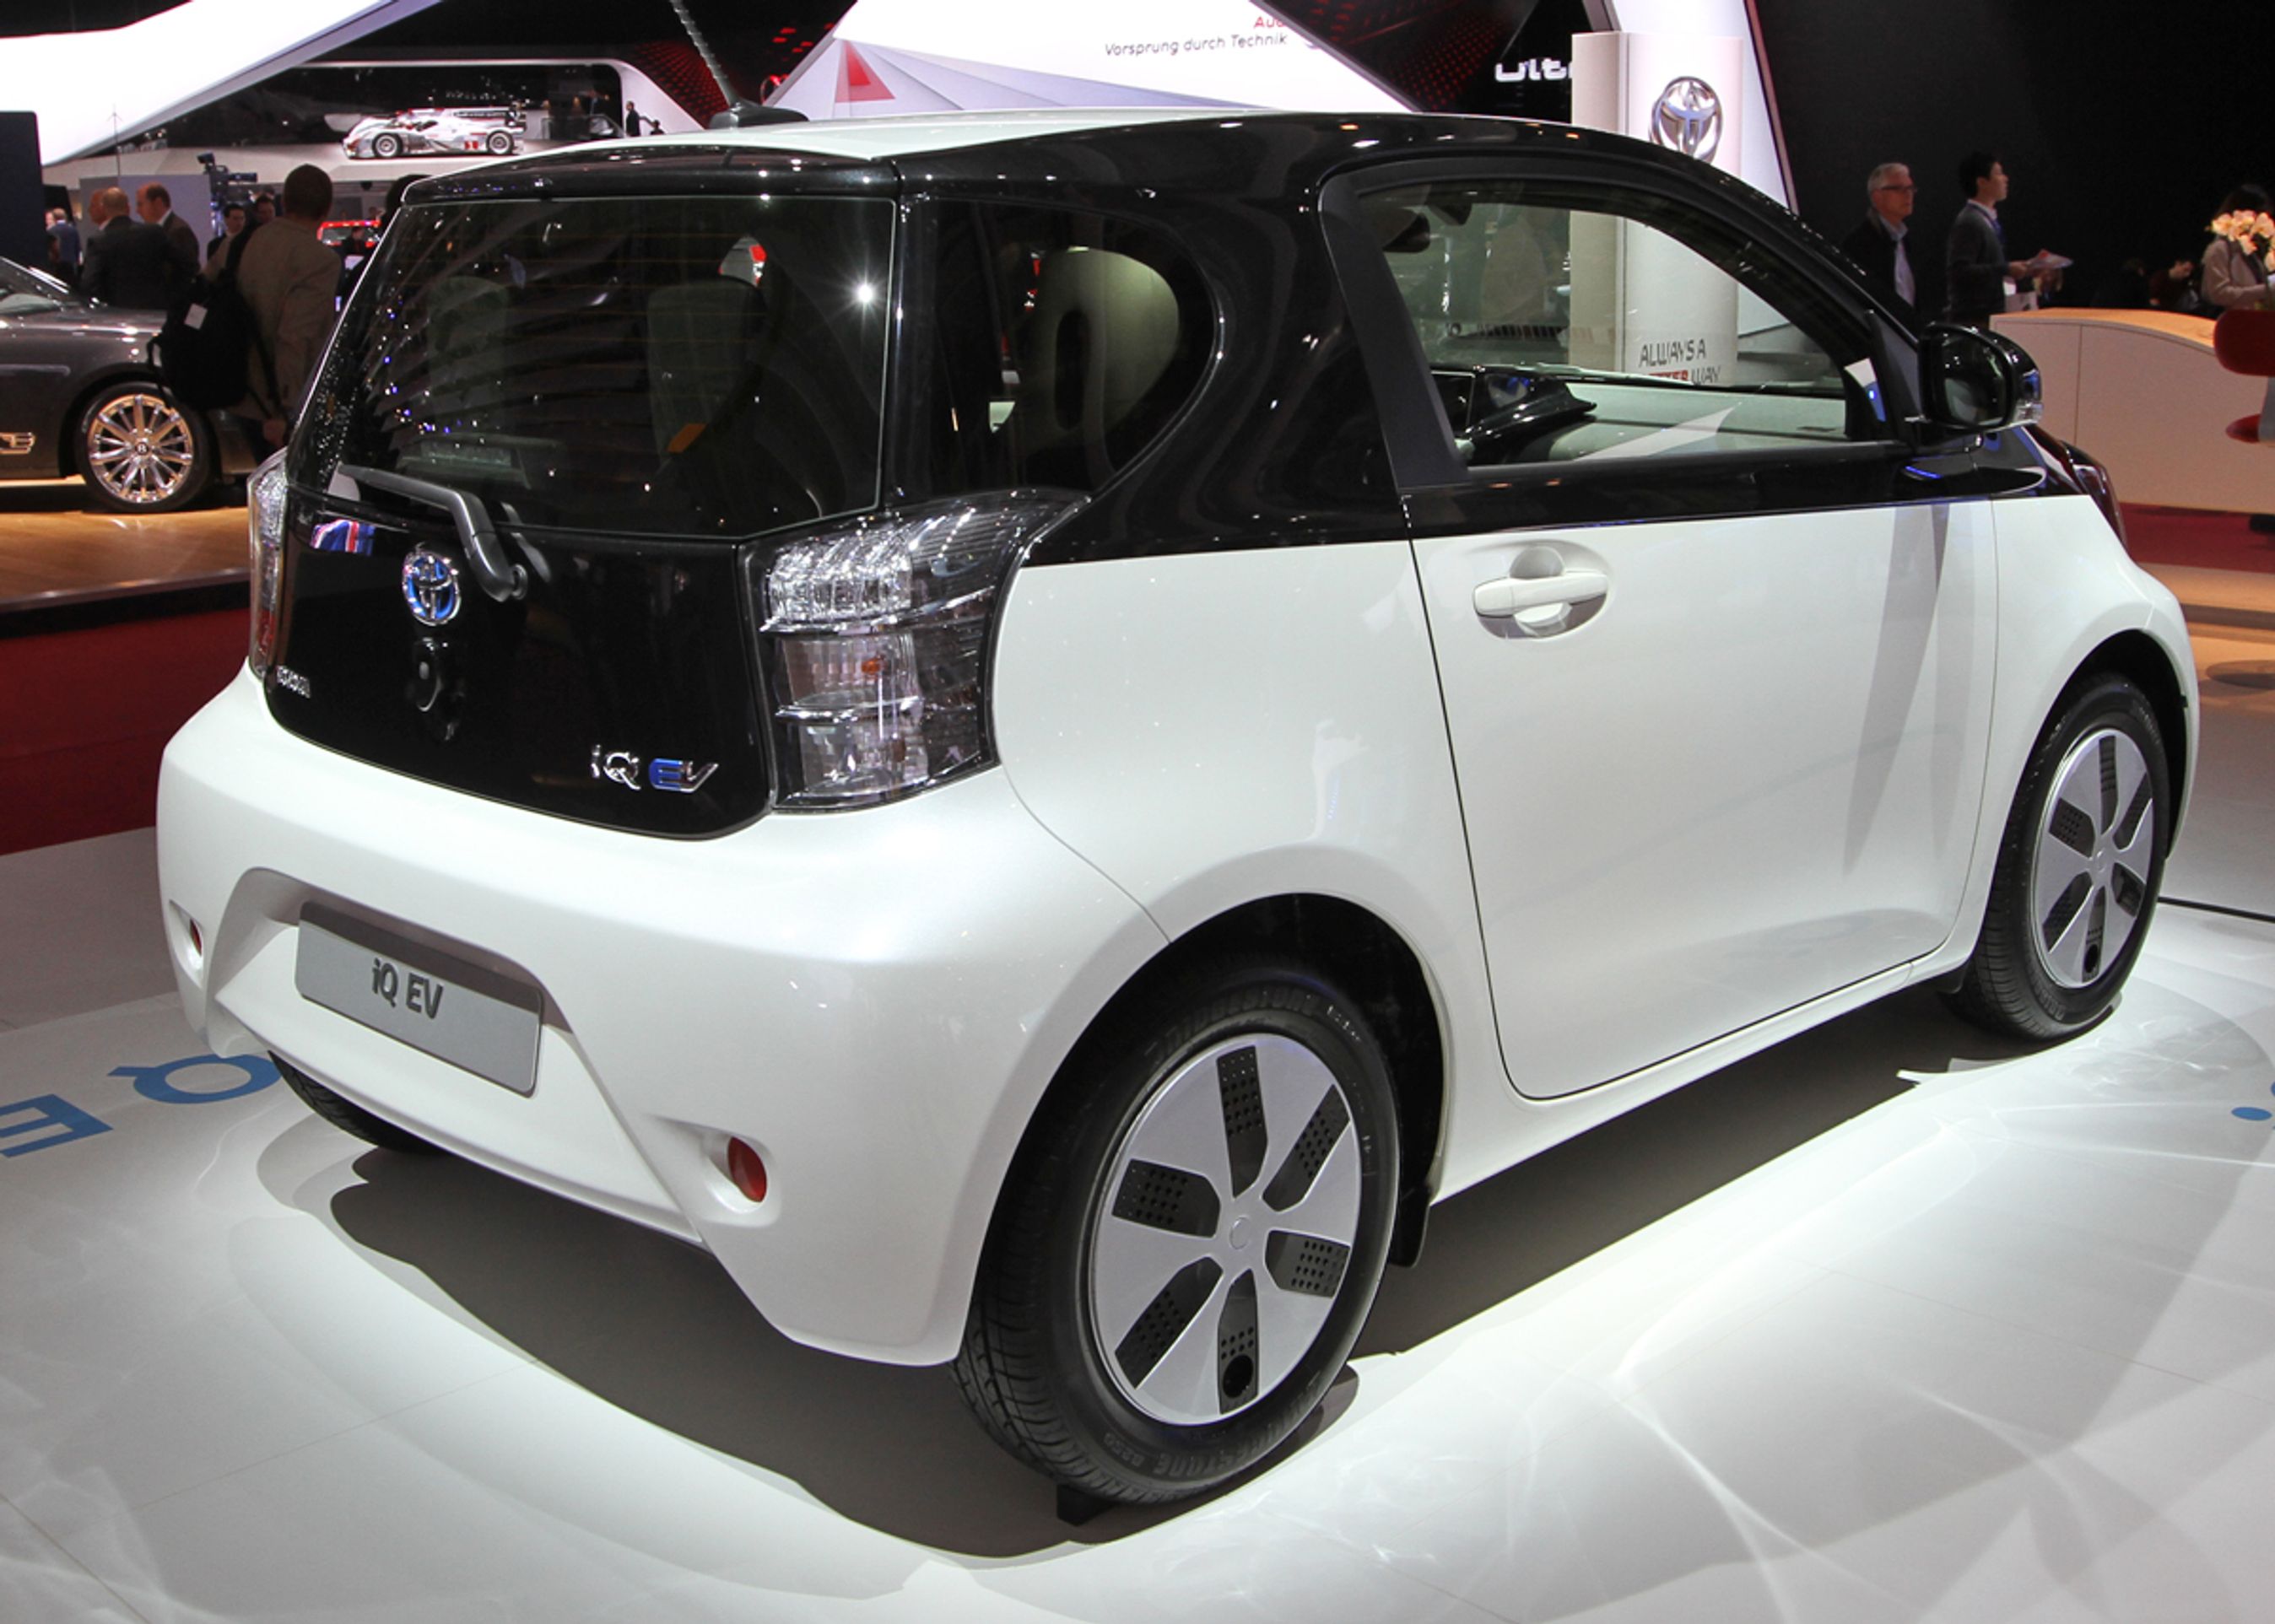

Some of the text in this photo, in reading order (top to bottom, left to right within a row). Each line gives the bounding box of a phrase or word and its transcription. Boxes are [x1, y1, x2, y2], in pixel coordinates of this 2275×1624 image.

[1105, 33, 1288, 57] Vorsprung durch Technik
[1639, 338, 1706, 368] ALWAYS A
[1691, 366, 1721, 386] WAY
[591, 744, 719, 793] iQ EV
[372, 958, 444, 1019] iQ EV
